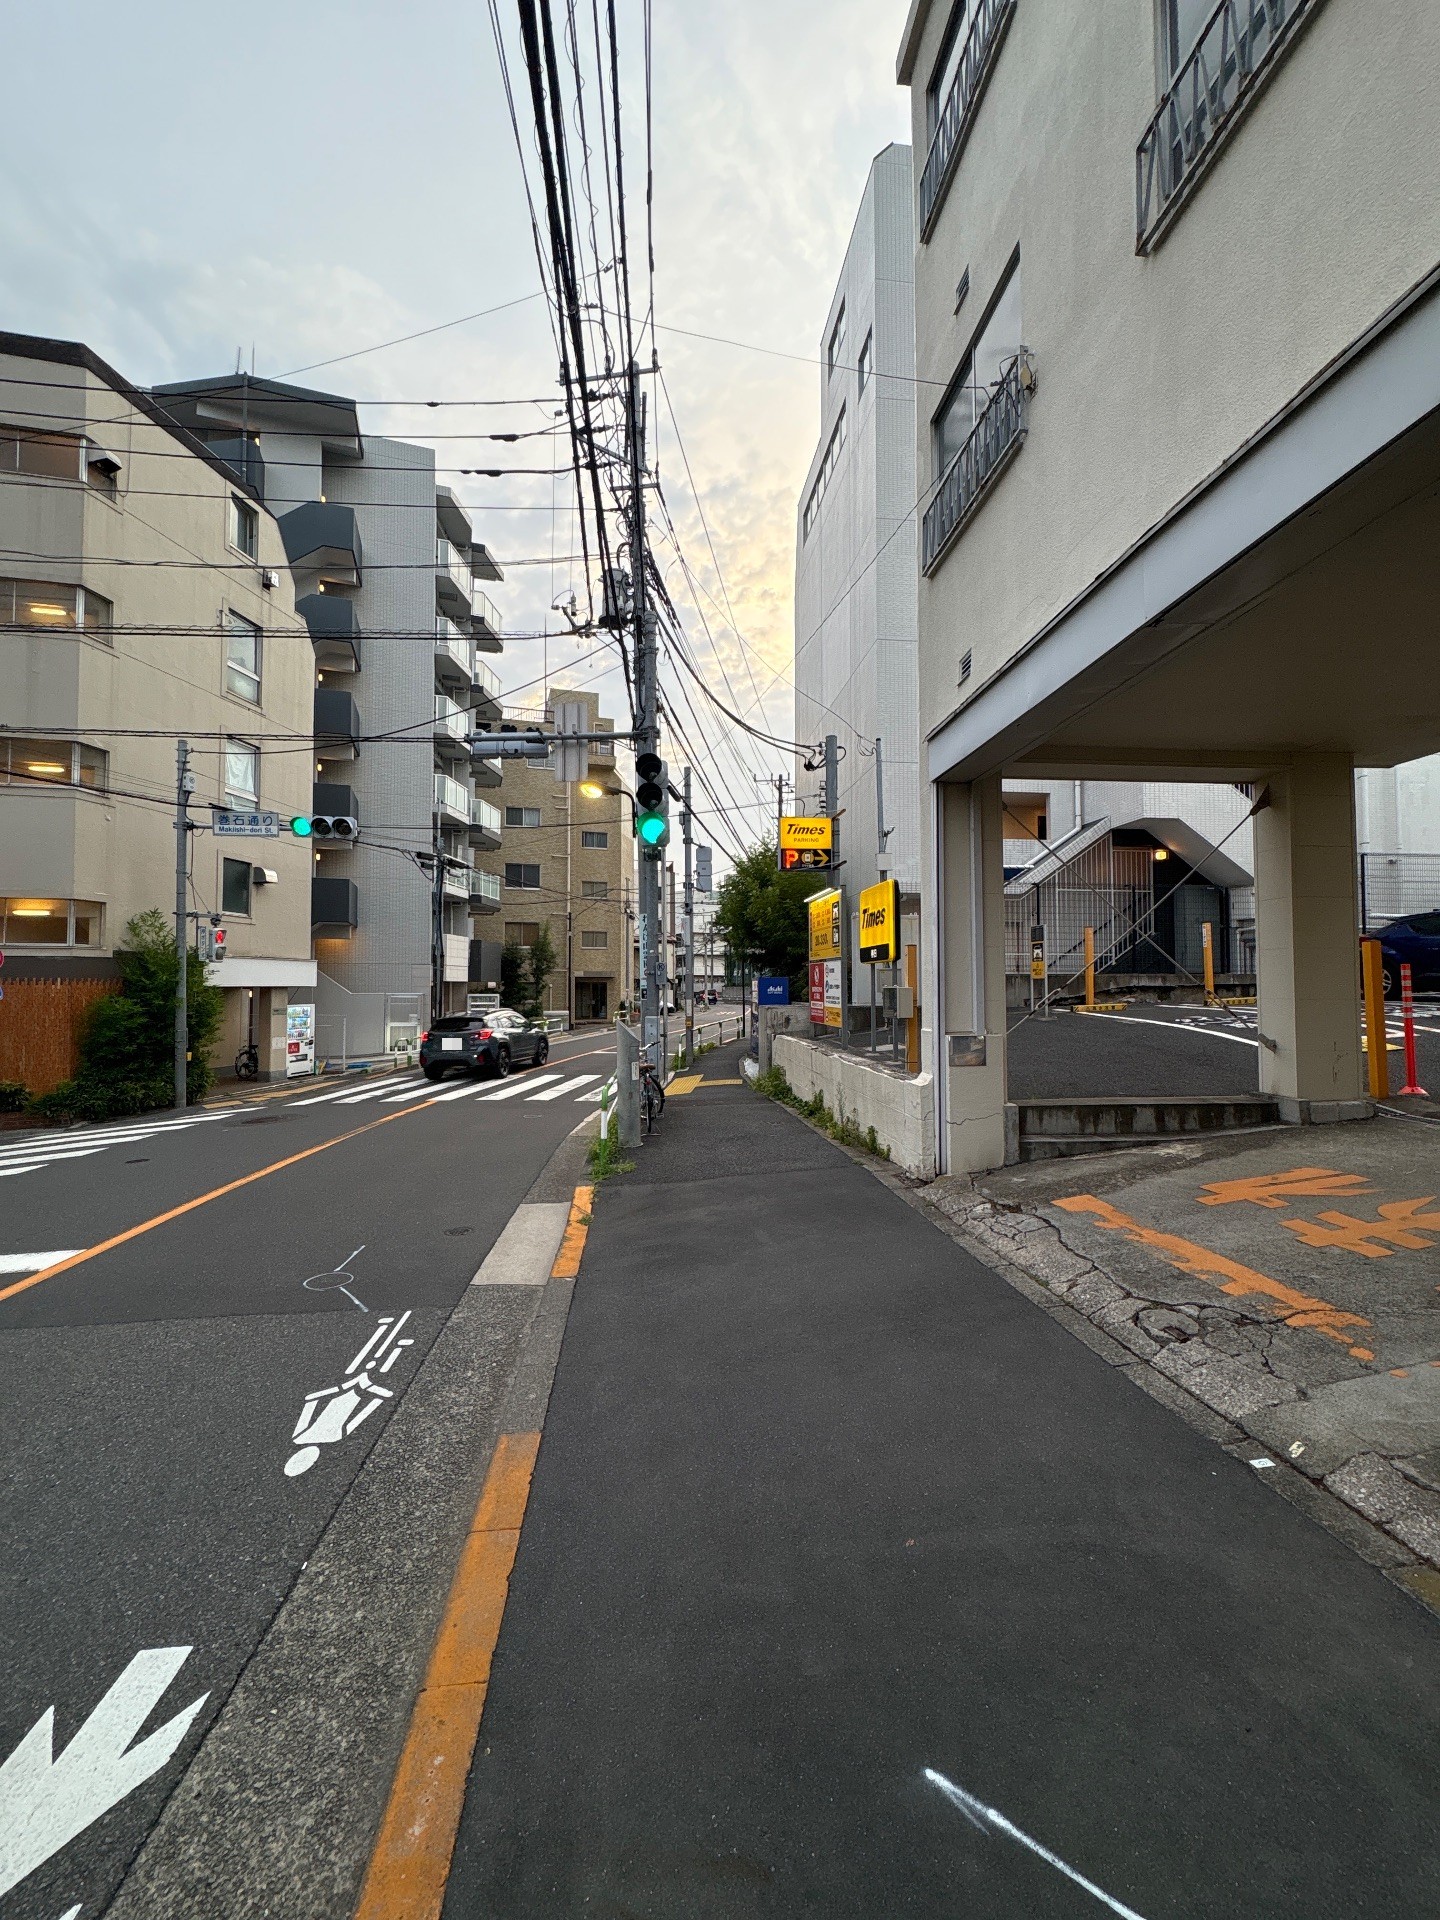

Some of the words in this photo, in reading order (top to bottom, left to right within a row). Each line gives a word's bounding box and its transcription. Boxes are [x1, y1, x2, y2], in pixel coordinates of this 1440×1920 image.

[217, 815, 273, 826] 巻石通り
[786, 823, 826, 835] Times
[862, 907, 886, 929] Times
